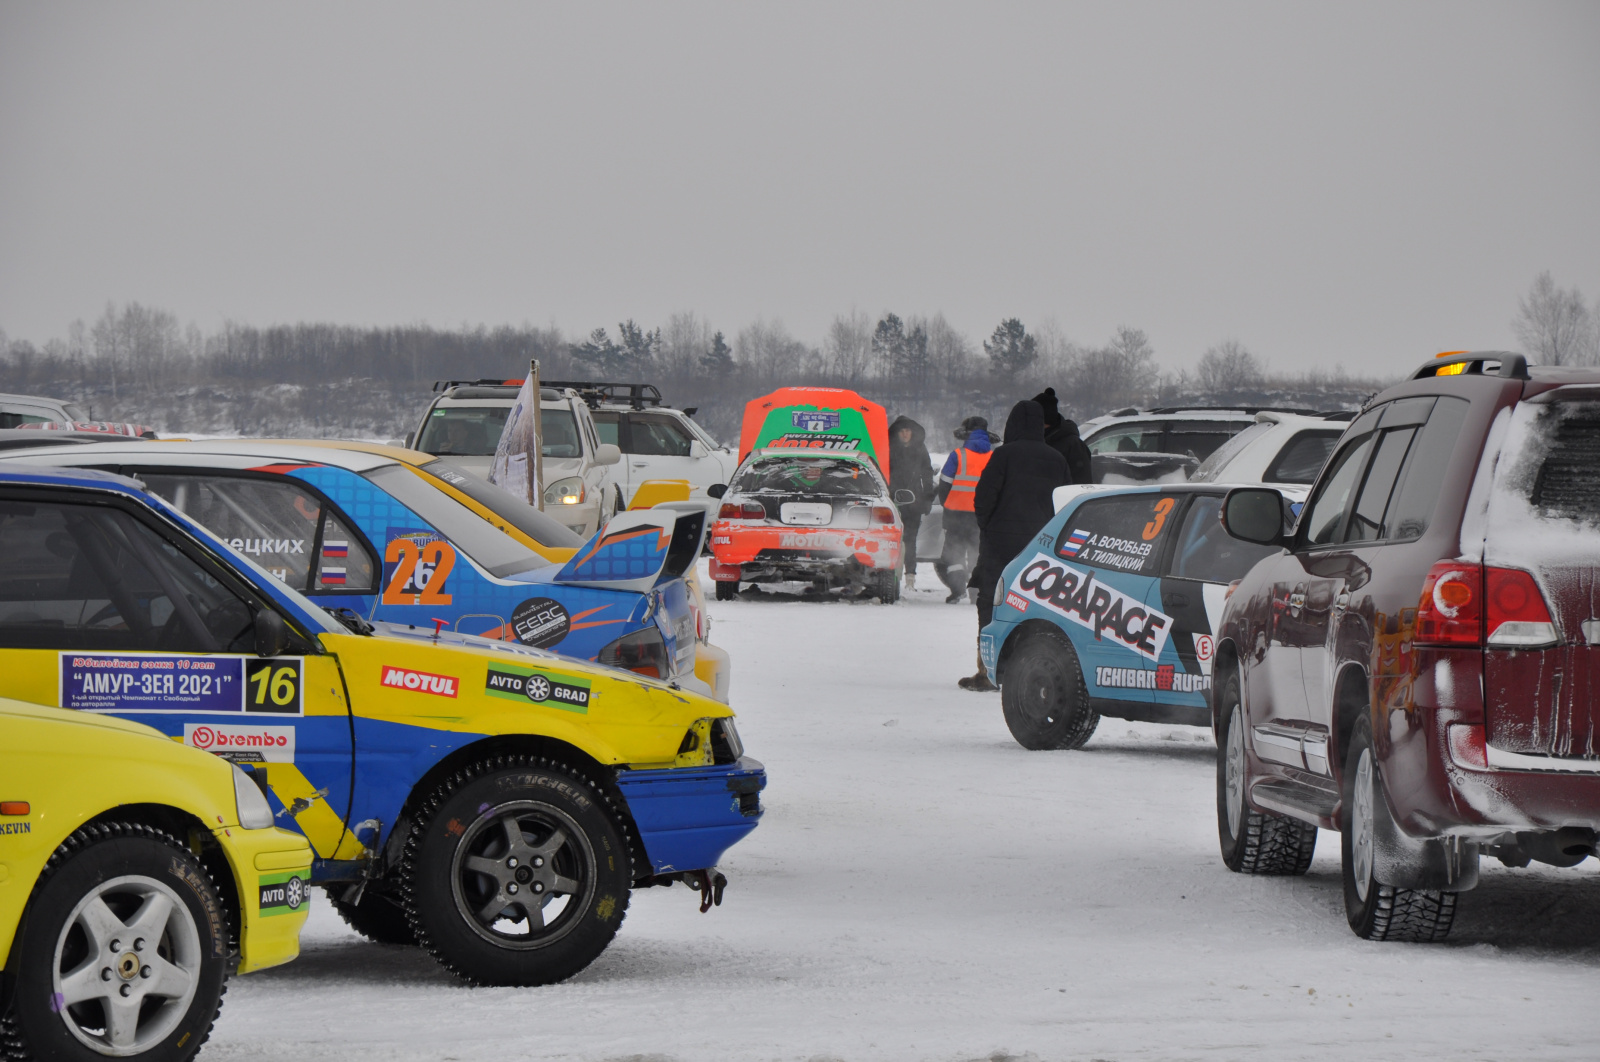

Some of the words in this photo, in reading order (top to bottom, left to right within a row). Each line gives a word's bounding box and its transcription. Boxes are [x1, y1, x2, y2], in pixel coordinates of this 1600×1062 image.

[1142, 497, 1175, 541] 3
[222, 538, 304, 556] ецких
[1087, 534, 1097, 546] А.
[1098, 535, 1152, 556] ВОРОБЬЕВ
[382, 538, 456, 605] 22
[1078, 547, 1089, 559] А.
[1091, 550, 1145, 571] ТИЛИЦКИЙ
[1007, 593, 1028, 611] MOTUL
[1020, 559, 1166, 657] COBARACE
[515, 605, 564, 635] FERC
[1201, 640, 1209, 655] E
[73, 658, 139, 668] Юбилейная
[141, 661, 175, 669] гонка
[177, 660, 189, 669] 10
[191, 661, 216, 669] лет
[250, 666, 297, 705] 16
[384, 669, 455, 696] MOTUL
[490, 675, 522, 690] AVTO
[554, 687, 587, 703] GRAD
[216, 731, 288, 747] brembo
[514, 774, 591, 810] MICHELIN
[261, 888, 285, 904] AVTO
[185, 873, 222, 956] MICHELIN
